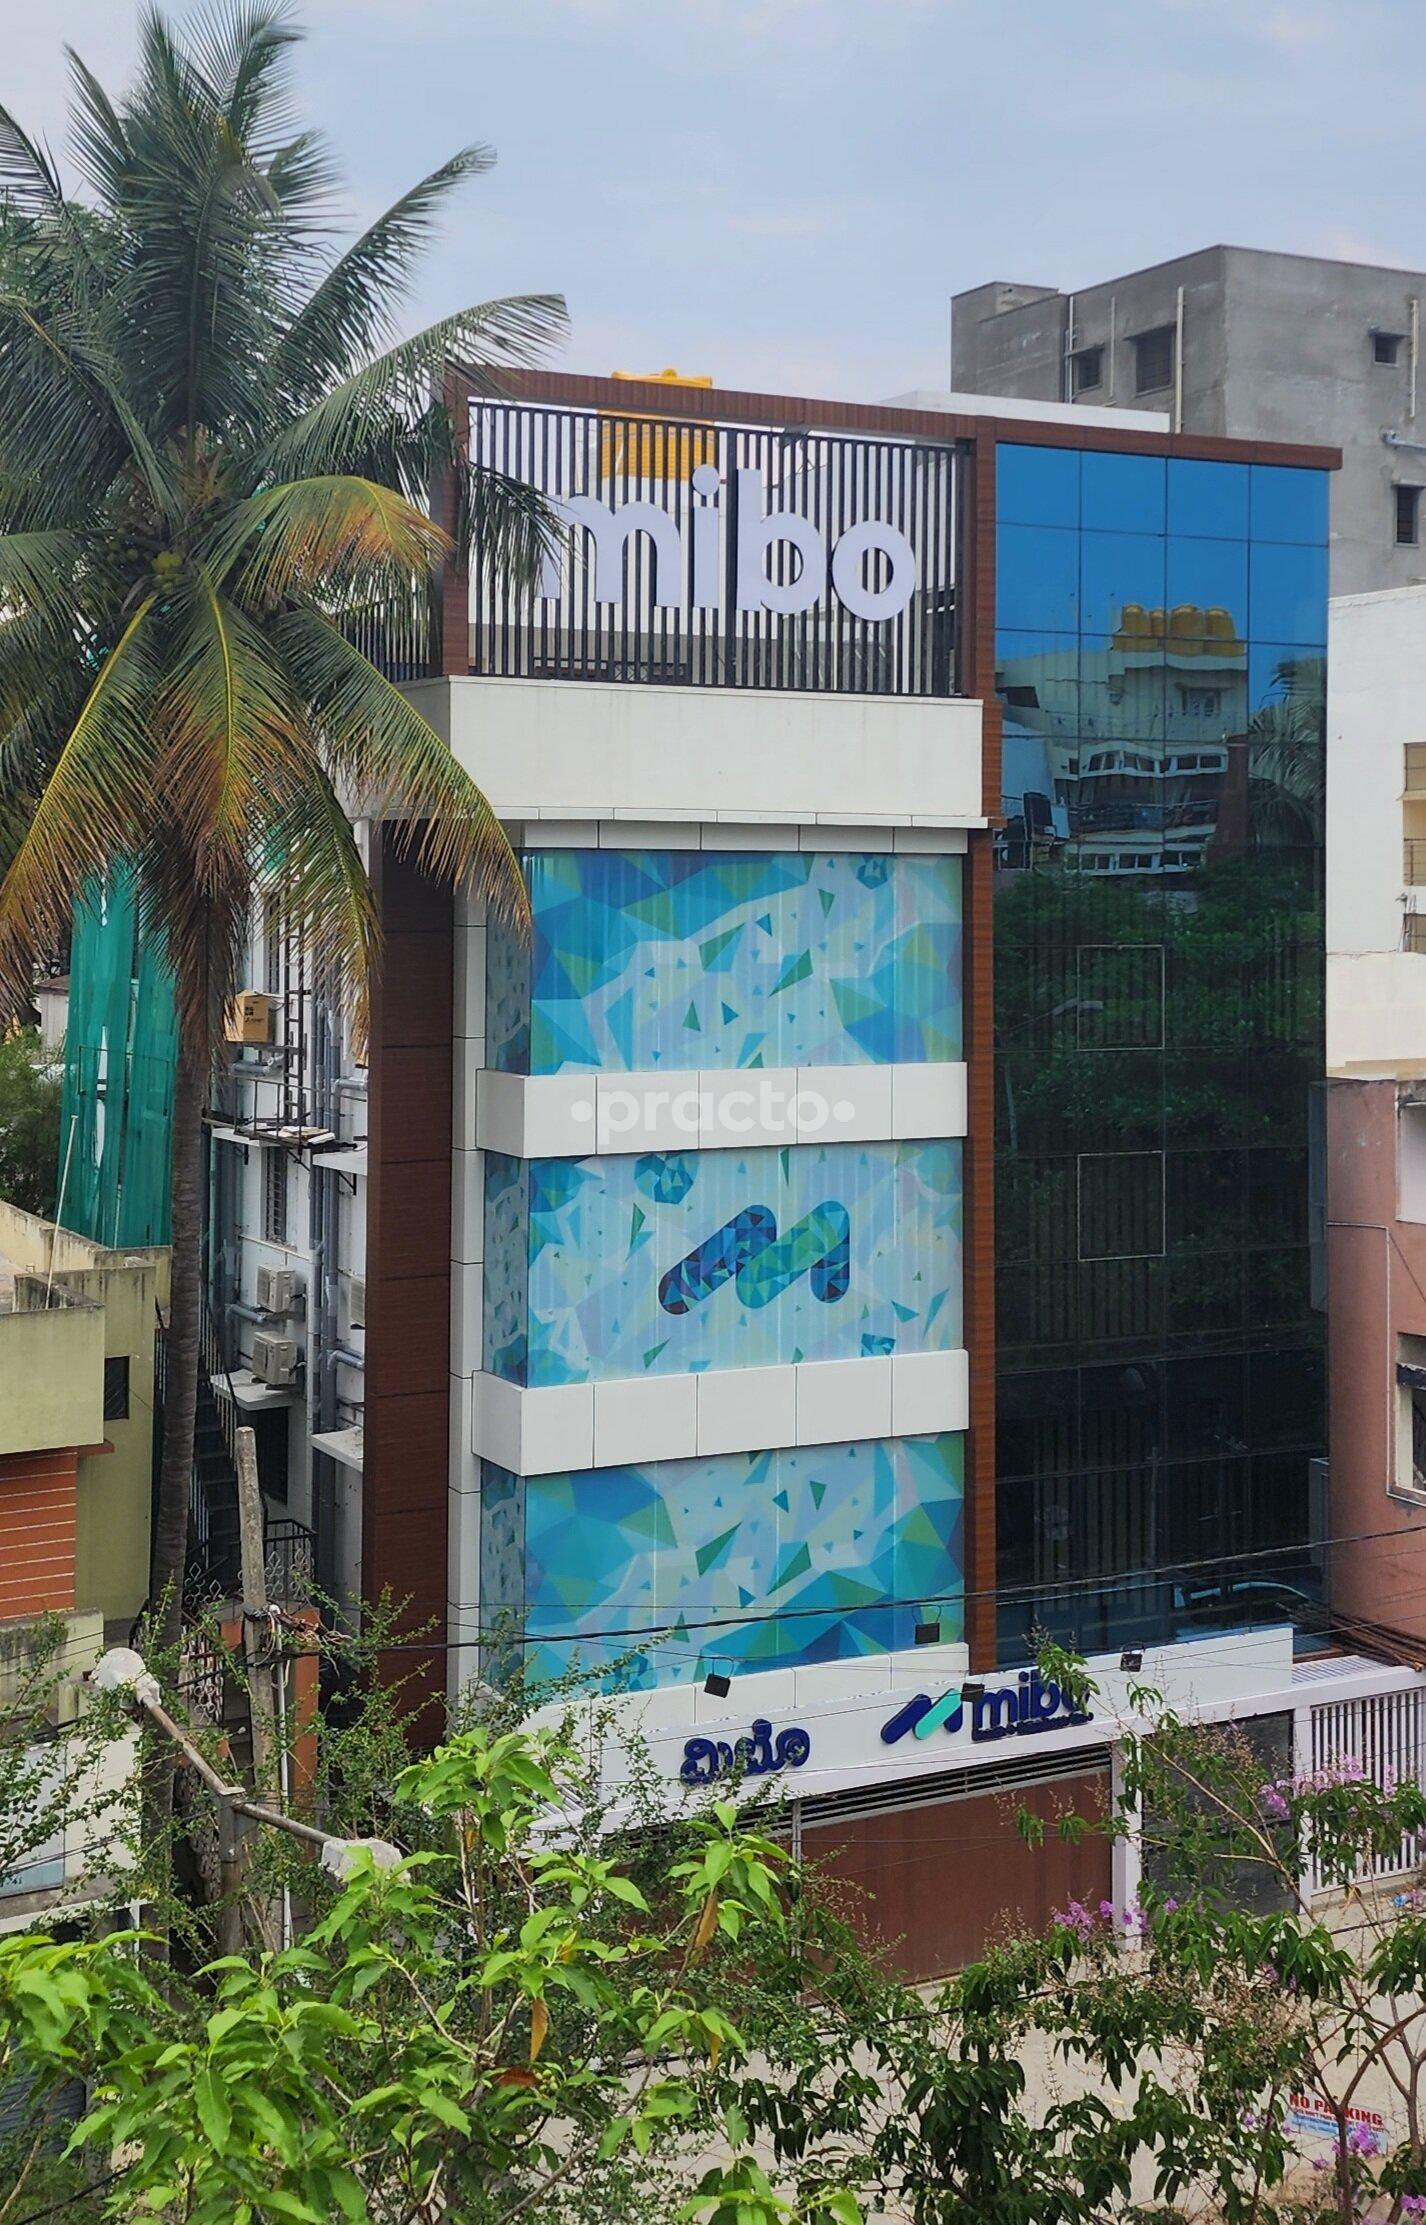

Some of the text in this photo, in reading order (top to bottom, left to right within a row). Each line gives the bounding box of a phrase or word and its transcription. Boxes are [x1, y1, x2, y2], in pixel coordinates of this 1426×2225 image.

[532, 464, 916, 621] mibo
[1289, 2094, 1310, 2109] NO
[1314, 2100, 1383, 2126] PAKING
